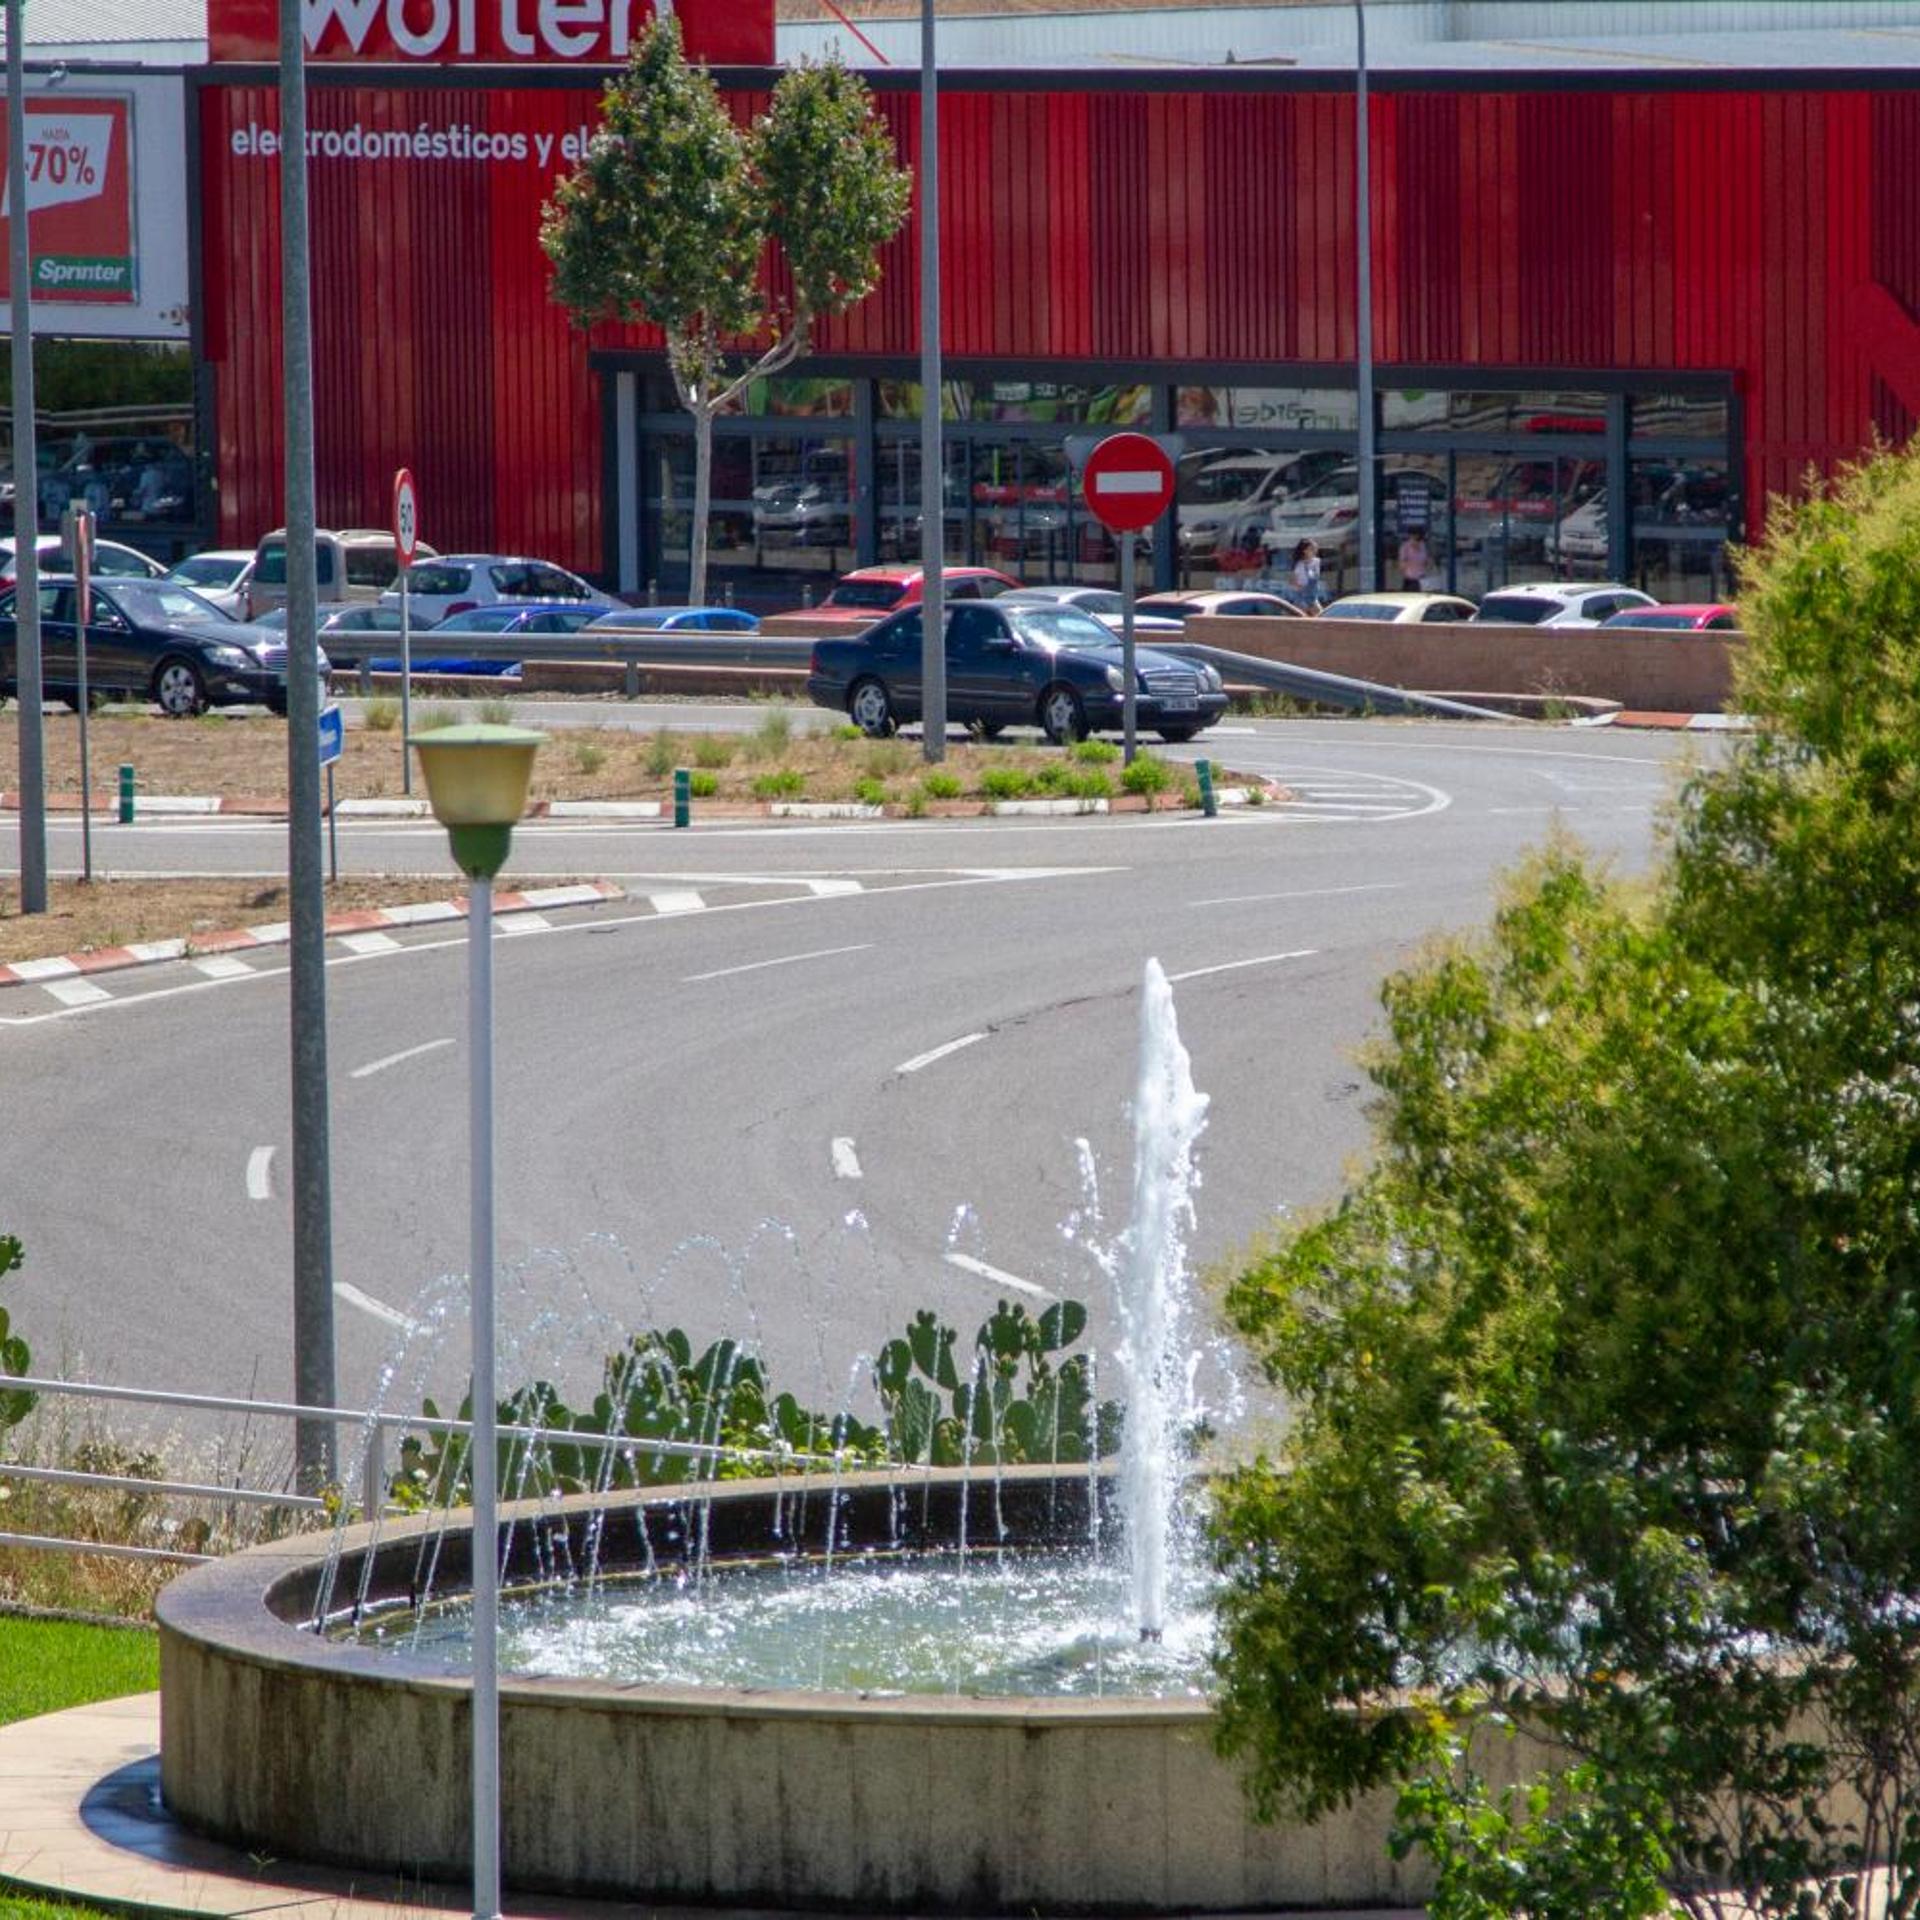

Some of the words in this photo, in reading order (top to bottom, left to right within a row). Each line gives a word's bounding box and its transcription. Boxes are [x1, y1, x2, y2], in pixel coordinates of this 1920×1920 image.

[231, 121, 528, 161] elerodomésticos
[534, 132, 554, 168] y
[38, 259, 124, 284] Sprinter
